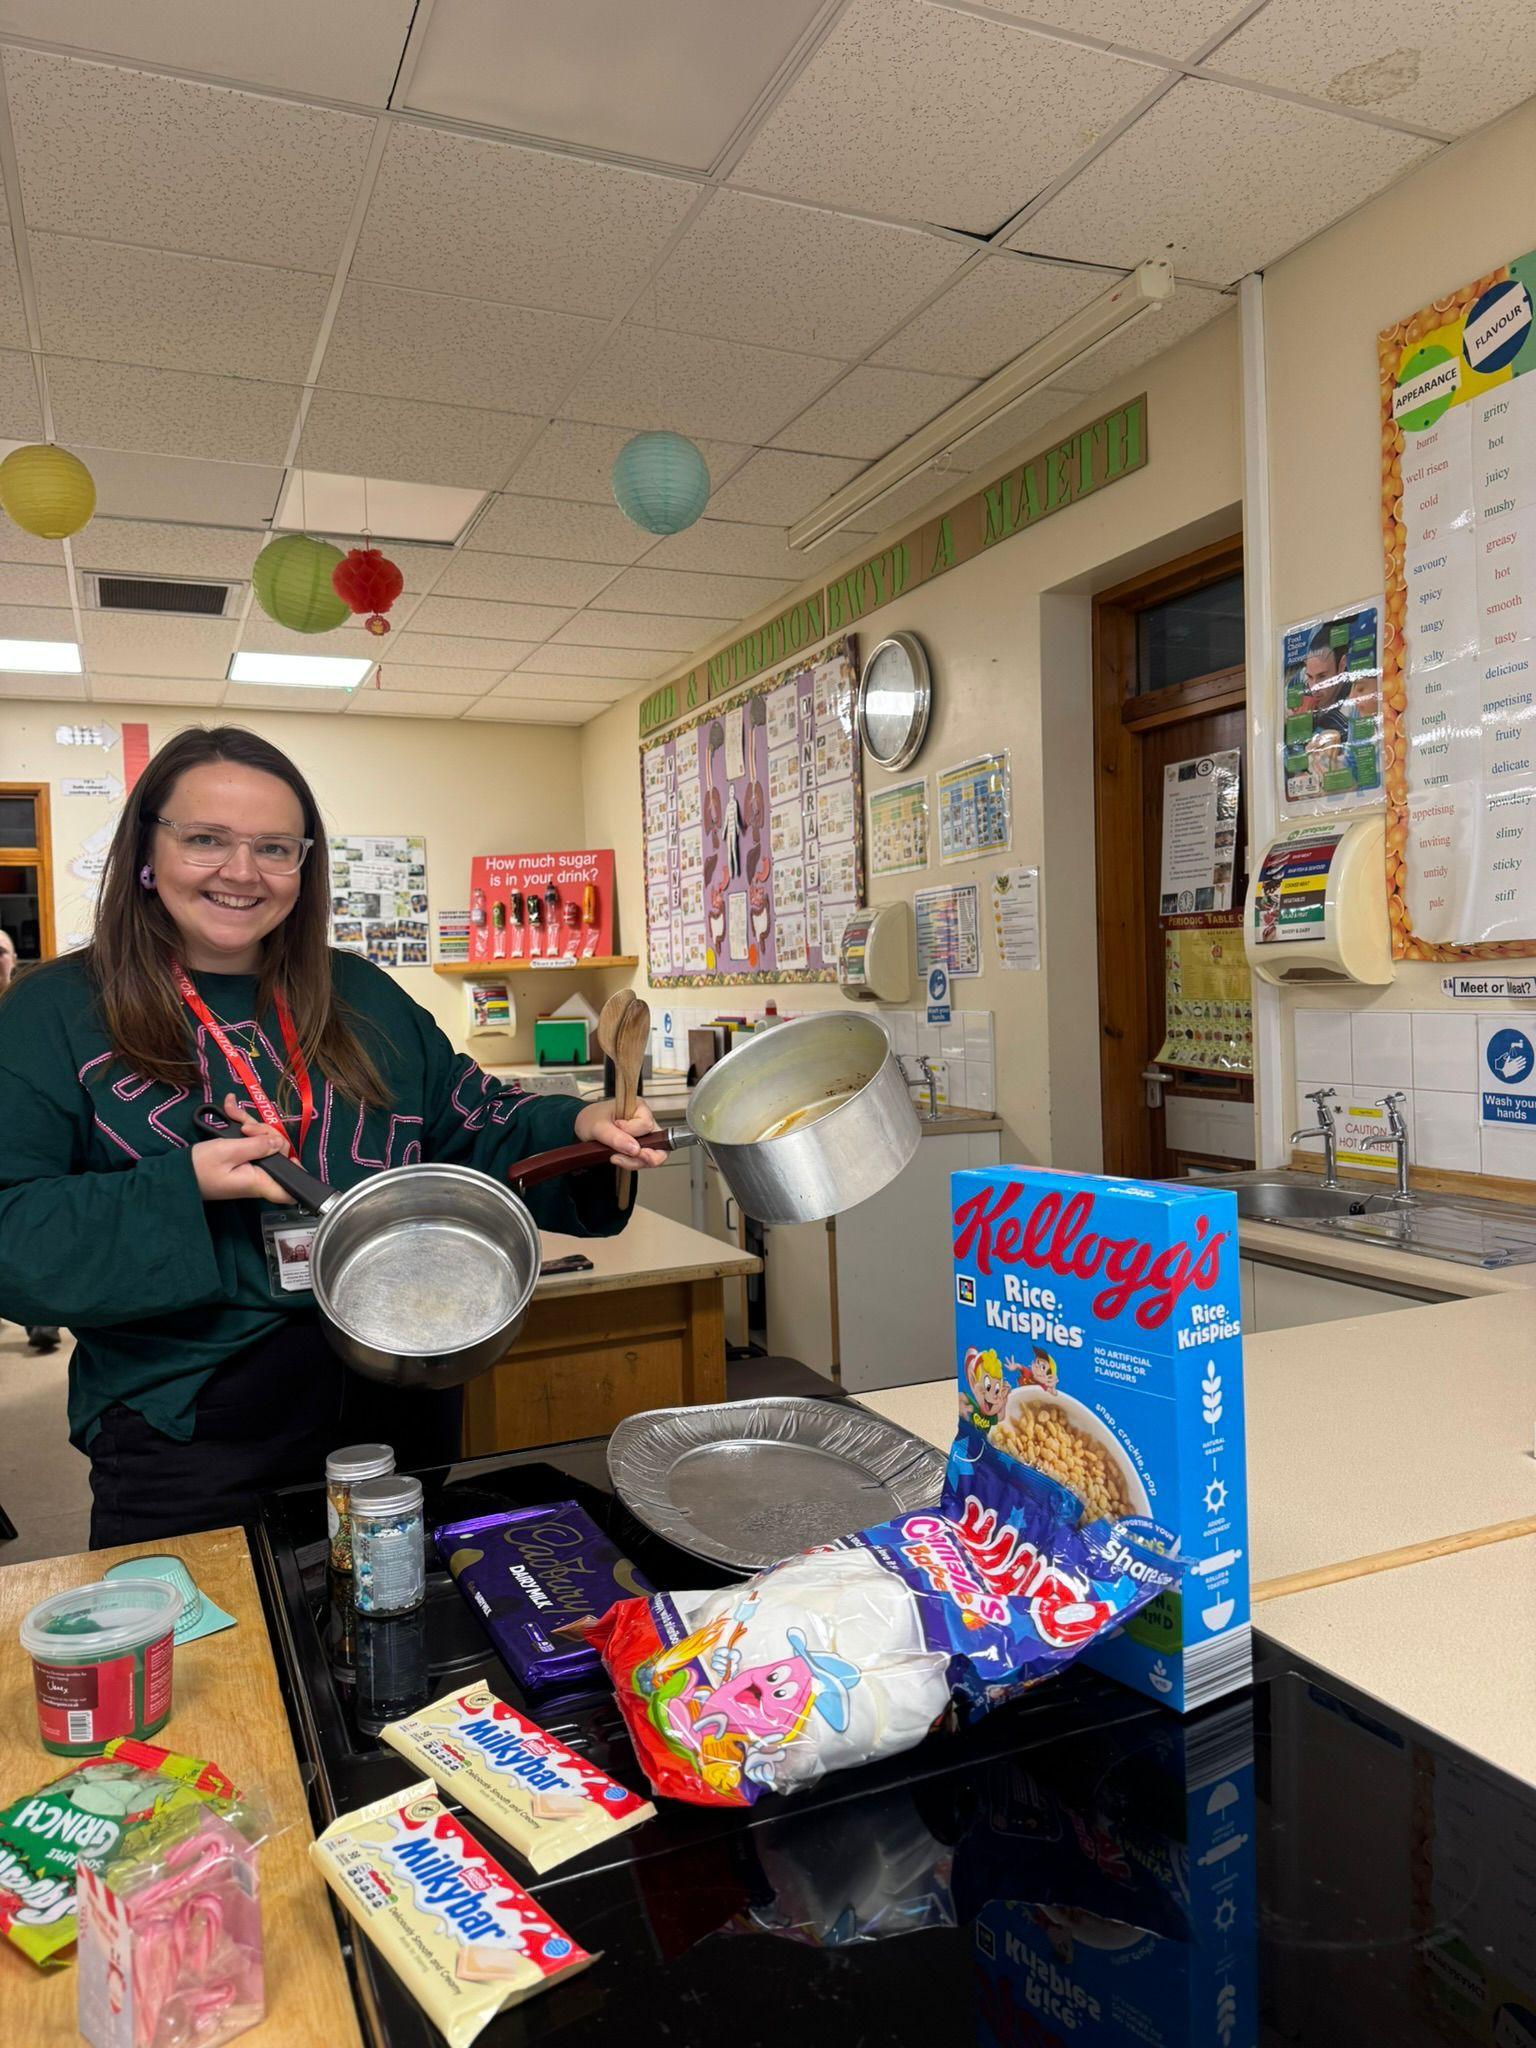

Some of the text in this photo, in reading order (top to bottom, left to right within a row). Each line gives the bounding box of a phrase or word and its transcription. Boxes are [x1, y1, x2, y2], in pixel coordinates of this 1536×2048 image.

[1474, 304, 1523, 350] FLAVOUR
[1395, 367, 1458, 410] APPEARANCE
[1482, 401, 1510, 424] gritty
[1416, 432, 1439, 450] burnt
[1488, 435, 1505, 450] hot
[1405, 460, 1449, 485] well risen
[1484, 466, 1511, 487] juicy
[1419, 494, 1439, 511] cold
[1483, 498, 1516, 518] mushy
[827, 400, 1144, 630] BWYD A MAETH
[1422, 526, 1438, 542] dry
[1485, 530, 1518, 553] greasy
[1412, 555, 1448, 575] savoury
[1494, 566, 1511, 580] hot
[1419, 588, 1443, 605] spicy
[1486, 594, 1522, 615] smooth
[1420, 618, 1445, 634] tangy
[1494, 629, 1518, 646] tasty
[686, 671, 698, 710] &
[708, 594, 823, 693] NUTRITION
[1423, 650, 1445, 664] salty
[1485, 660, 1529, 679] delicious
[1425, 681, 1442, 694] thin
[1482, 692, 1532, 714] appetising
[1421, 711, 1447, 726] tough
[1495, 726, 1522, 742] fruity
[1419, 742, 1450, 757] watery
[1491, 758, 1530, 775] delicate
[1423, 773, 1449, 785] warm
[1412, 803, 1455, 822] appetising
[1419, 835, 1451, 849] inviting
[1495, 826, 1524, 840] slimy
[486, 854, 598, 871] How much sugar
[1423, 865, 1449, 879] untidy
[1492, 857, 1522, 871] sticky
[489, 867, 599, 888] is in your drink?
[1495, 888, 1518, 902] stiff
[1168, 915, 1203, 927] PERIODIC
[1204, 912, 1234, 924] TABLE
[1460, 981, 1531, 994] Meet or Meat?
[206, 1020, 238, 1058] VISITOR
[248, 1082, 278, 1125] VISITOR
[1485, 1094, 1536, 1109] Wash your
[1496, 1109, 1527, 1120] hands
[1345, 1123, 1388, 1136] CAUTION
[1339, 1137, 1394, 1152] HOT ATER!
[953, 1181, 1227, 1330] Kellogg's
[1003, 1273, 1057, 1311] Rice
[985, 1299, 1084, 1349] Krispies
[1191, 1303, 1225, 1326] Rice
[1177, 1316, 1241, 1351] Krispies
[1094, 1346, 1152, 1368] NO ARTIFICIAL
[1094, 1357, 1146, 1376] COLOURS OR
[1094, 1366, 1137, 1384] FLAVOURS
[1095, 1403, 1157, 1496] snap, crackle, pop
[503, 1522, 597, 1615] Cadbury
[509, 1564, 539, 1594] DAIRY
[529, 1588, 554, 1610] MILK
[458, 1719, 570, 1792] Milkybar
[465, 1768, 540, 1830] Deliciously Smooth and Creamy
[12, 1798, 121, 1858] GRINCH
[45, 1847, 77, 1869] APPLE
[391, 1836, 506, 1941] Milkybar
[388, 1905, 462, 1996] Deliciously Smooth and Creamy
